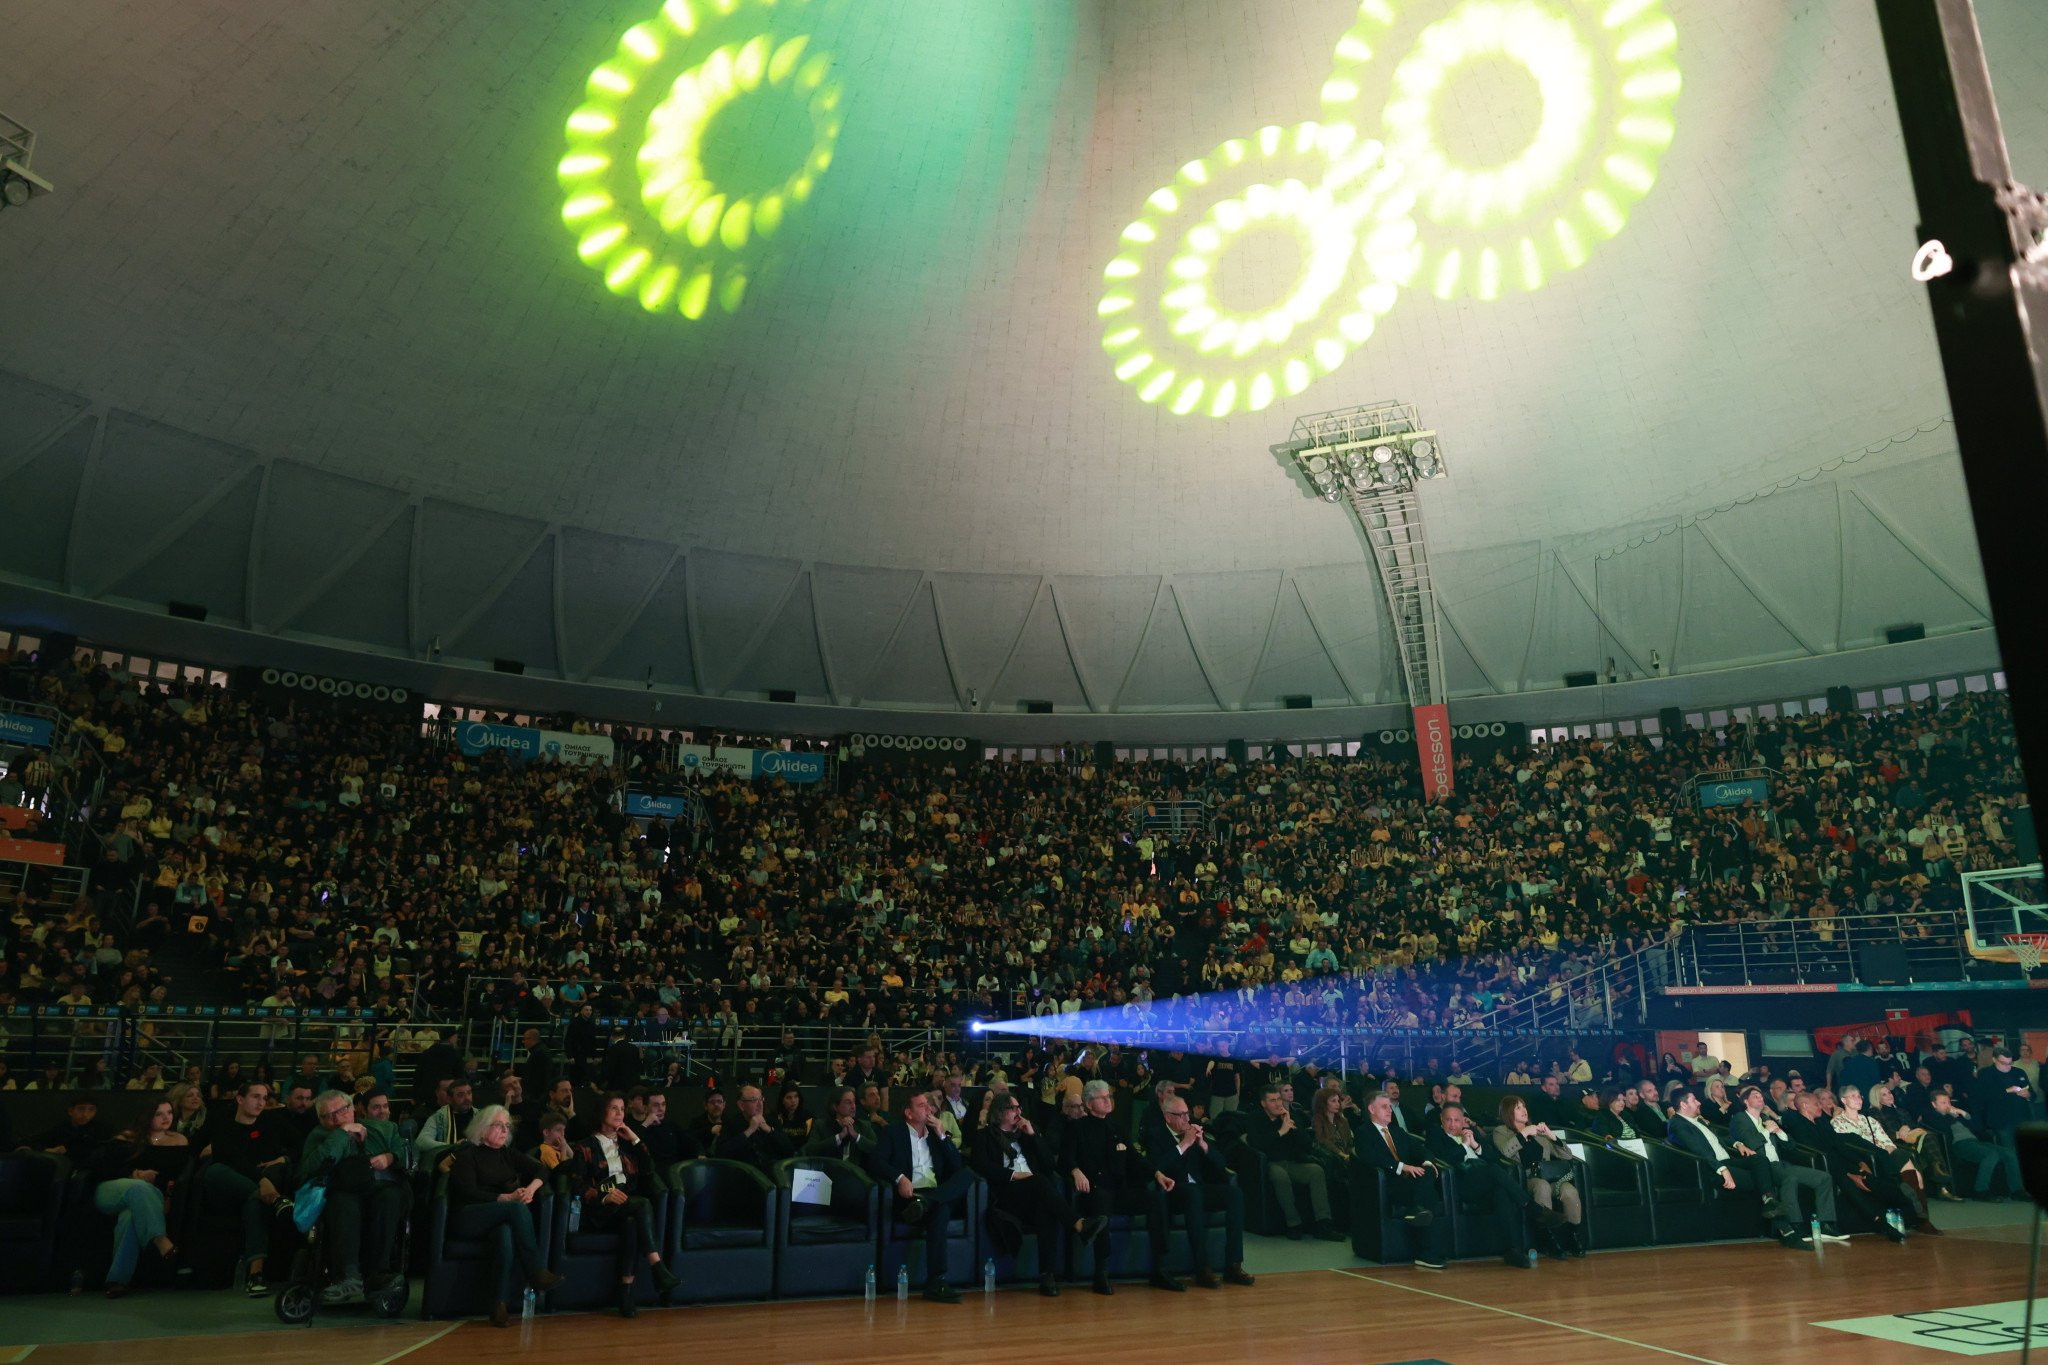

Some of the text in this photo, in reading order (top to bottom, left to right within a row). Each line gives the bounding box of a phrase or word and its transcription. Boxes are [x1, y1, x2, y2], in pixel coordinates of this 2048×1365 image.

[477, 731, 530, 750] Midea
[770, 757, 818, 773] Midea
[1722, 787, 1753, 797] Midea
[646, 799, 672, 810] Midea
